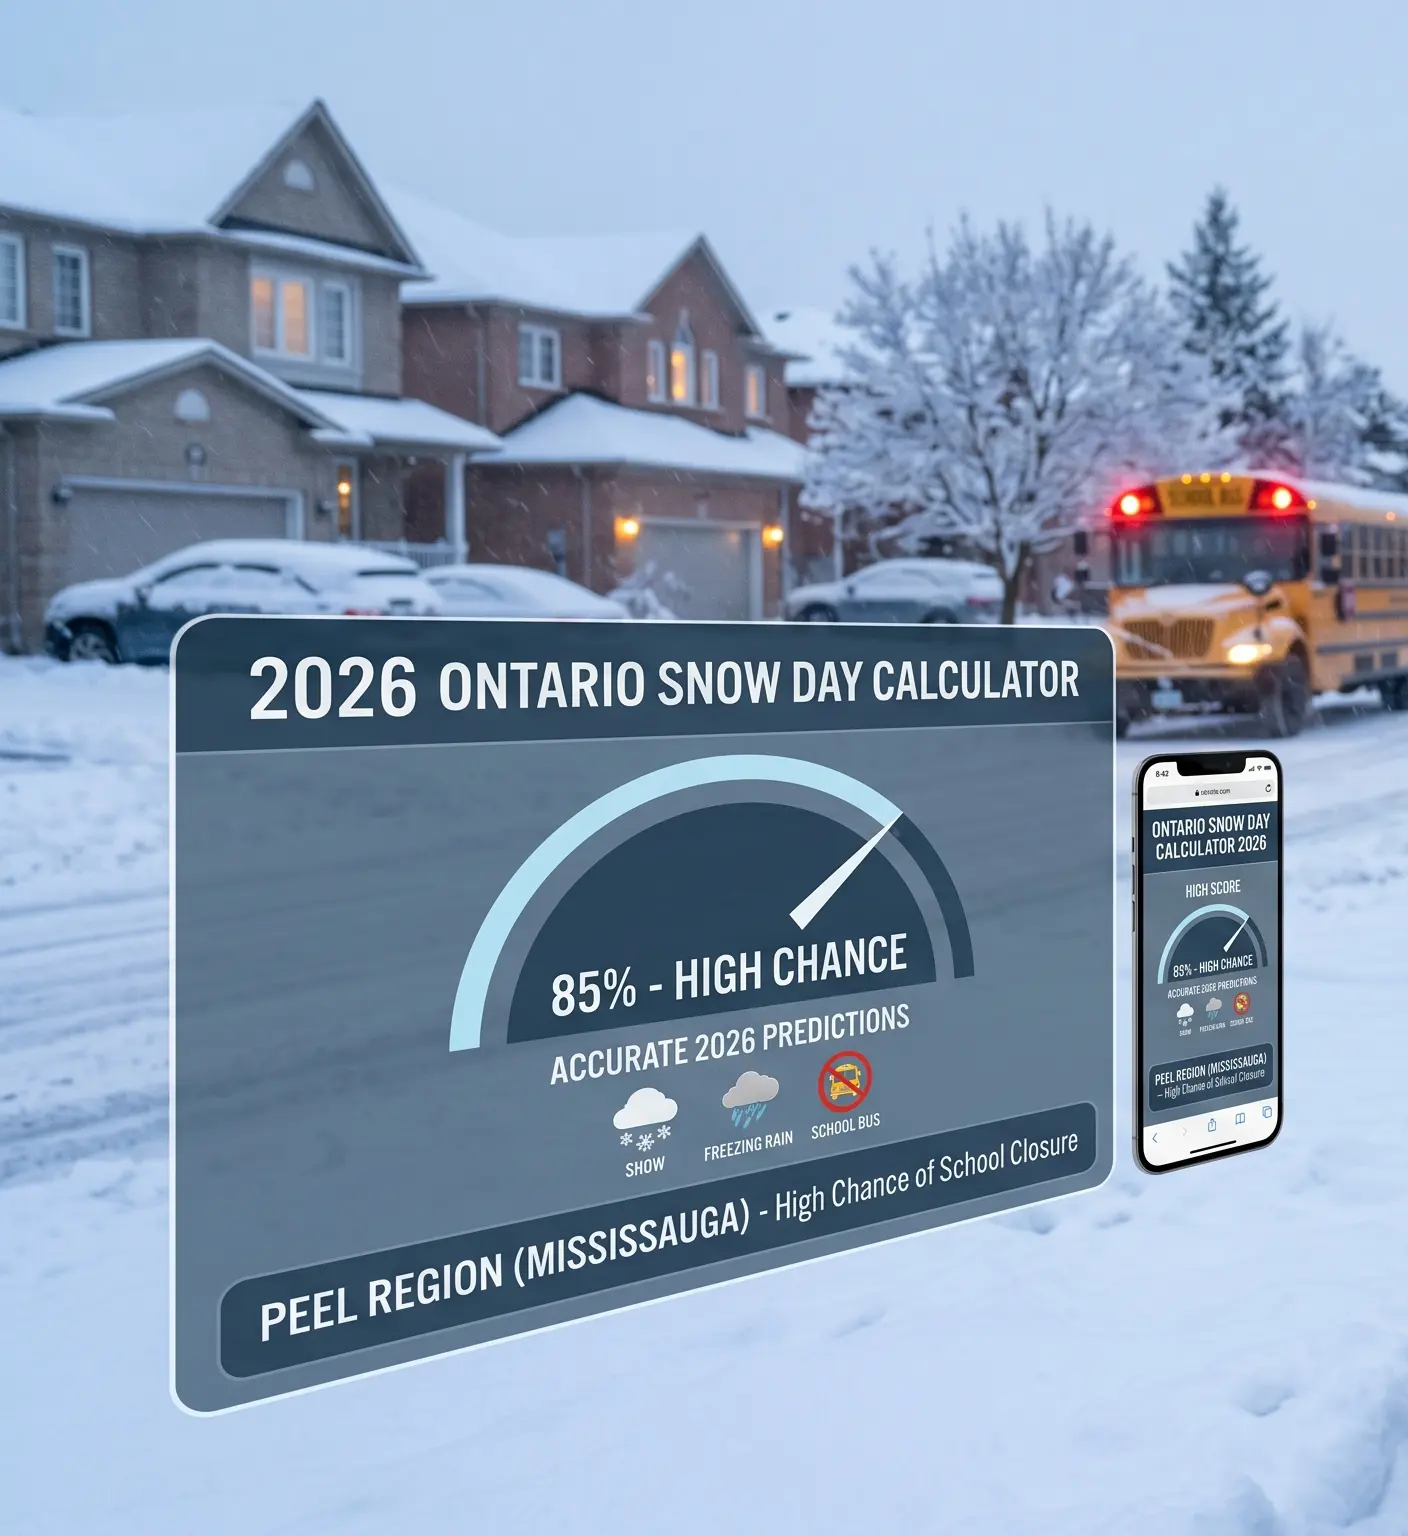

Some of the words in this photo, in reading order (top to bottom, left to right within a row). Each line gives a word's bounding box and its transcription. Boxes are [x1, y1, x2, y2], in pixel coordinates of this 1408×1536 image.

[1152, 817, 1206, 838] ONTARIO
[1208, 815, 1245, 834] SNOW
[1247, 813, 1271, 830] DAY
[1155, 837, 1235, 860] CALCULATOR
[1238, 834, 1267, 852] 2026
[1185, 882, 1209, 899] HIGH
[1210, 879, 1241, 896] SCORE
[1199, 959, 1219, 974] HIGH
[1220, 954, 1254, 970] CHANCE
[1155, 1071, 1175, 1086] PEEL
[1176, 1064, 1206, 1082] REGION
[1207, 1052, 1267, 1077] (MISSISSAUGA)
[1164, 1085, 1180, 1100] High
[1238, 1069, 1265, 1082] Closure
